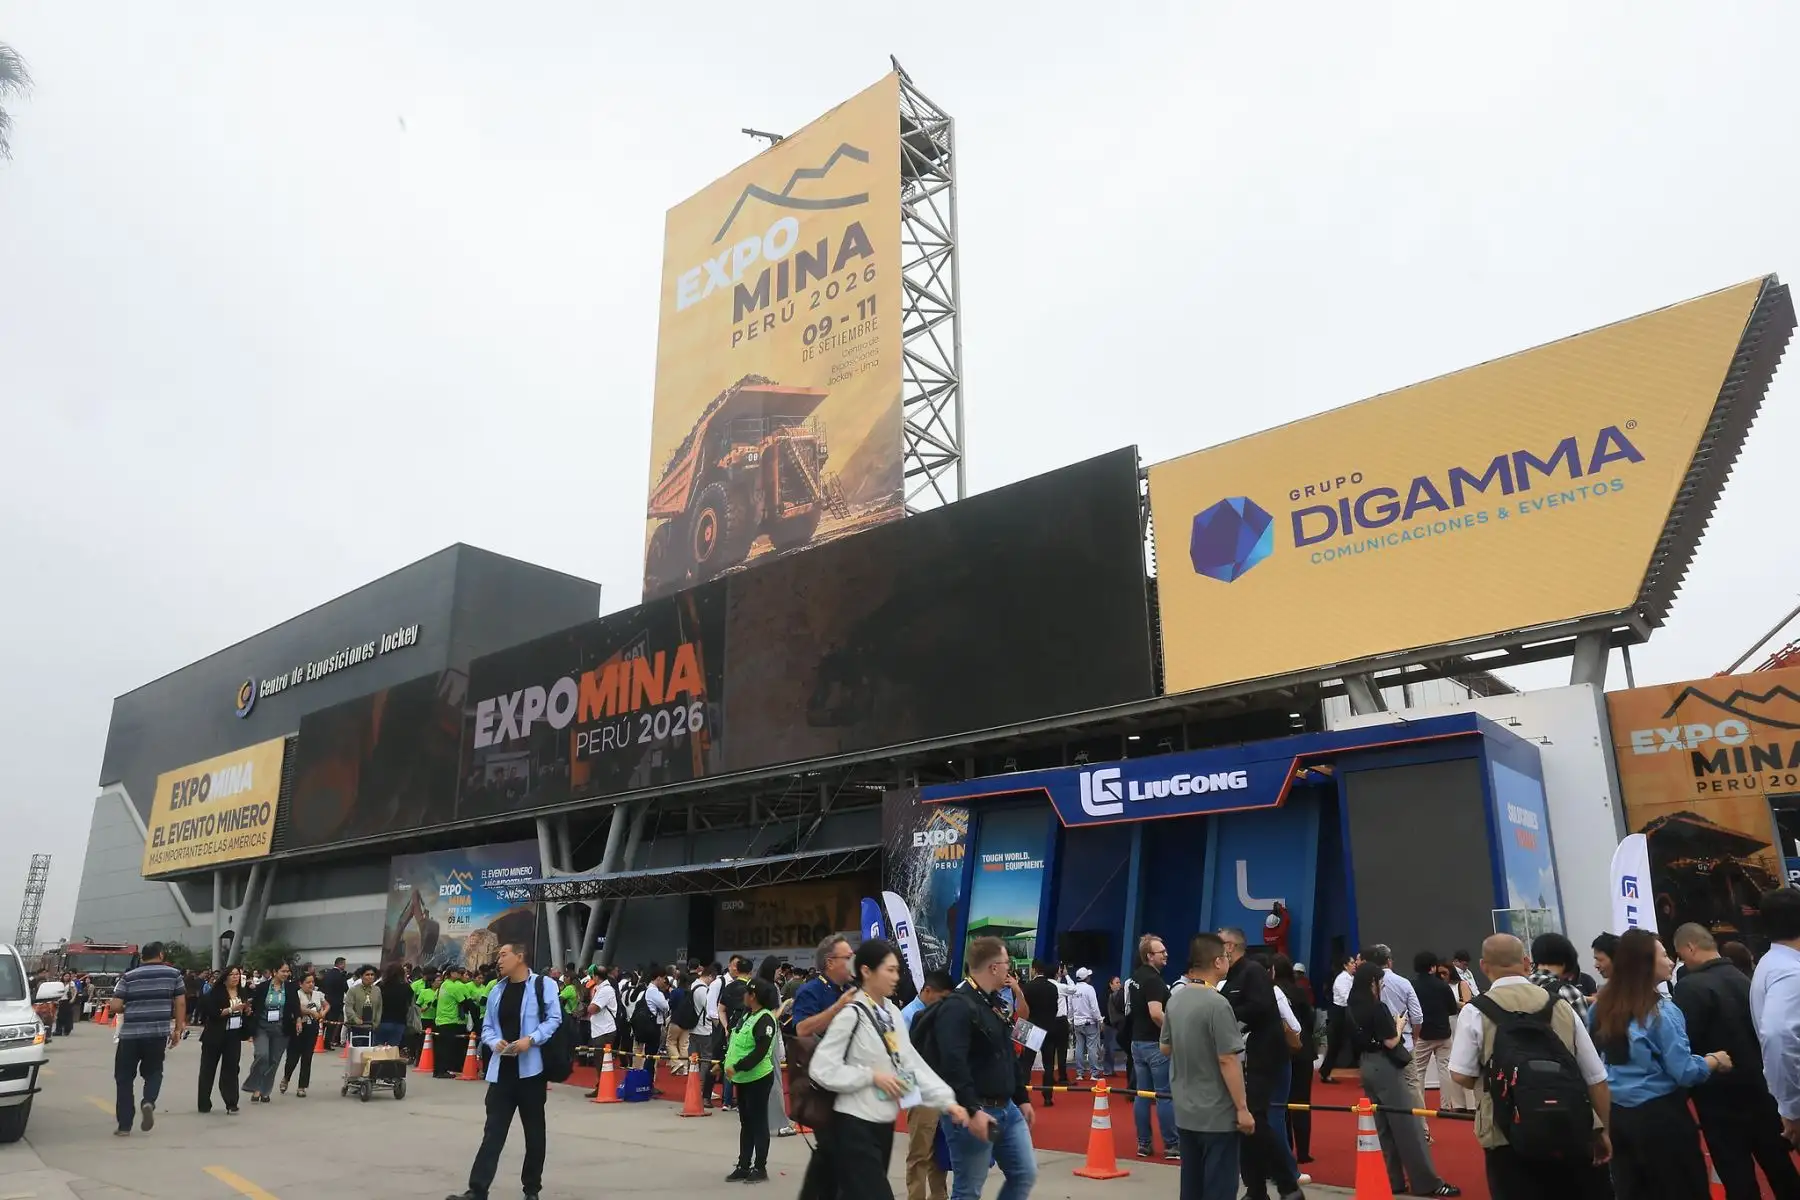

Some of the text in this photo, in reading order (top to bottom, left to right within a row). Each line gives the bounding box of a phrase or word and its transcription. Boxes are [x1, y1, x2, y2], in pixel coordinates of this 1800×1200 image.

[676, 216, 799, 312] EXPO
[732, 220, 875, 325] MINA
[731, 263, 877, 349] PERÚ 2026
[802, 315, 833, 346] 09
[856, 294, 878, 321] 11
[802, 317, 879, 363] DE SETIEMBRE
[1288, 471, 1364, 501] GRUPO
[1291, 425, 1646, 548] DIGAMMA
[1310, 478, 1625, 565] COMUNICACIONES & EVENTOS
[259, 624, 419, 698] Centro de Exposiciones Jockey
[473, 642, 702, 750] EXPOMINA
[576, 701, 704, 757] PERÚ 2026
[1630, 719, 1751, 755] EXPO
[170, 760, 254, 811] EXPOMINA
[1696, 774, 1757, 793] PERÚ
[151, 801, 271, 848] EL EVENTO MINERO
[913, 828, 959, 847] EXPO
[164, 844, 203, 862] IMPORTANTE
[982, 851, 1030, 863] TOUGH WORLD.
[1005, 860, 1045, 871] EQUIPMENT.
[439, 883, 462, 896] EXPO
[722, 899, 744, 911] EXPO
